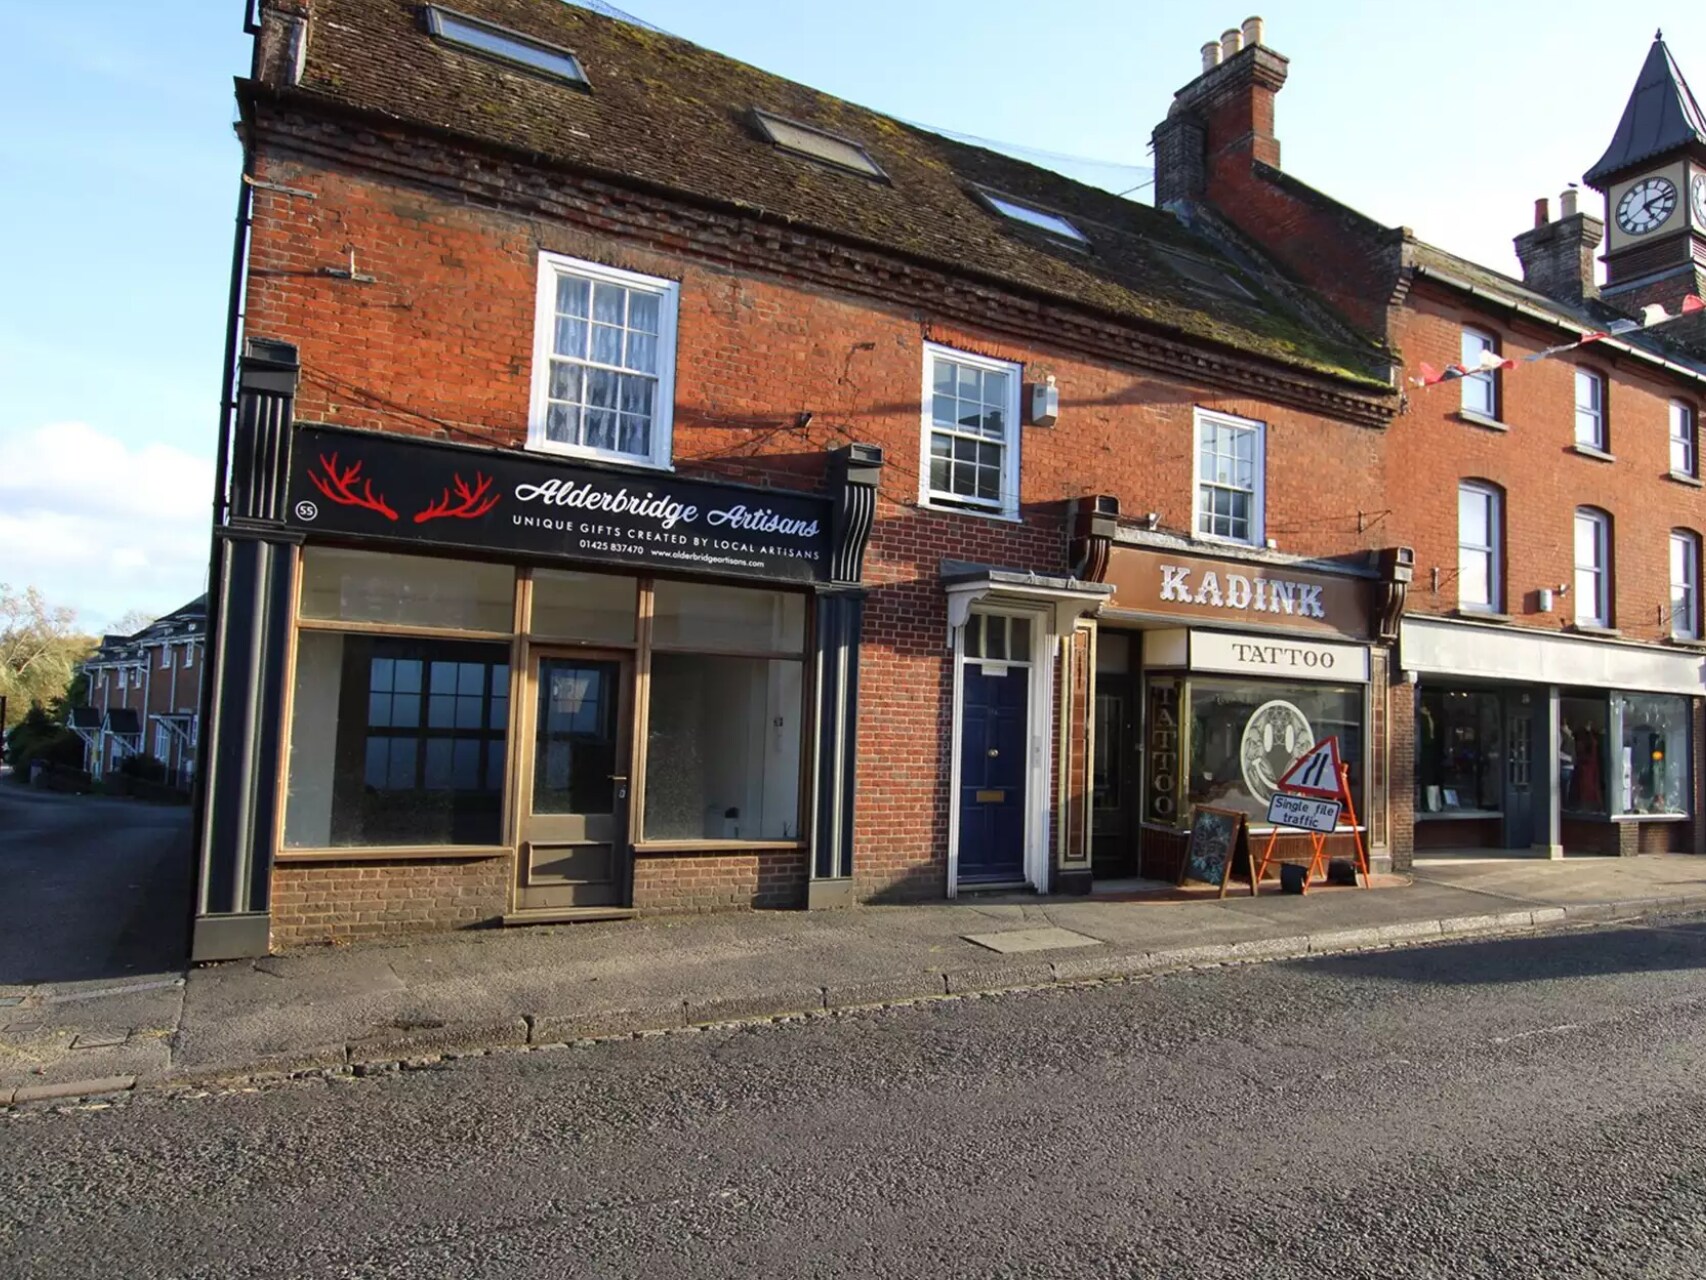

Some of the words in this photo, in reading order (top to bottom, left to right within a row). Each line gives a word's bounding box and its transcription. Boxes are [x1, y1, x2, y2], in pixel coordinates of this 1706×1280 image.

[515, 478, 698, 529] Alderbridge
[707, 505, 820, 537] Artisans
[513, 515, 573, 531] UNIQUE
[580, 523, 621, 537] GIFTS
[627, 529, 687, 544] CREATED
[693, 537, 708, 546] BY
[714, 539, 755, 553] LOCAL
[760, 546, 820, 560] ARTISANS
[579, 539, 608, 550] 01425
[610, 543, 644, 554] 837470
[651, 550, 765, 568] www.alderbridgeartisans.com
[1159, 564, 1325, 618] KADINK
[1232, 643, 1335, 669] TATTOO
[1152, 687, 1177, 814] TATTOO
[1275, 797, 1309, 813] Single
[1314, 803, 1334, 816] file
[1283, 812, 1319, 828] traffic
